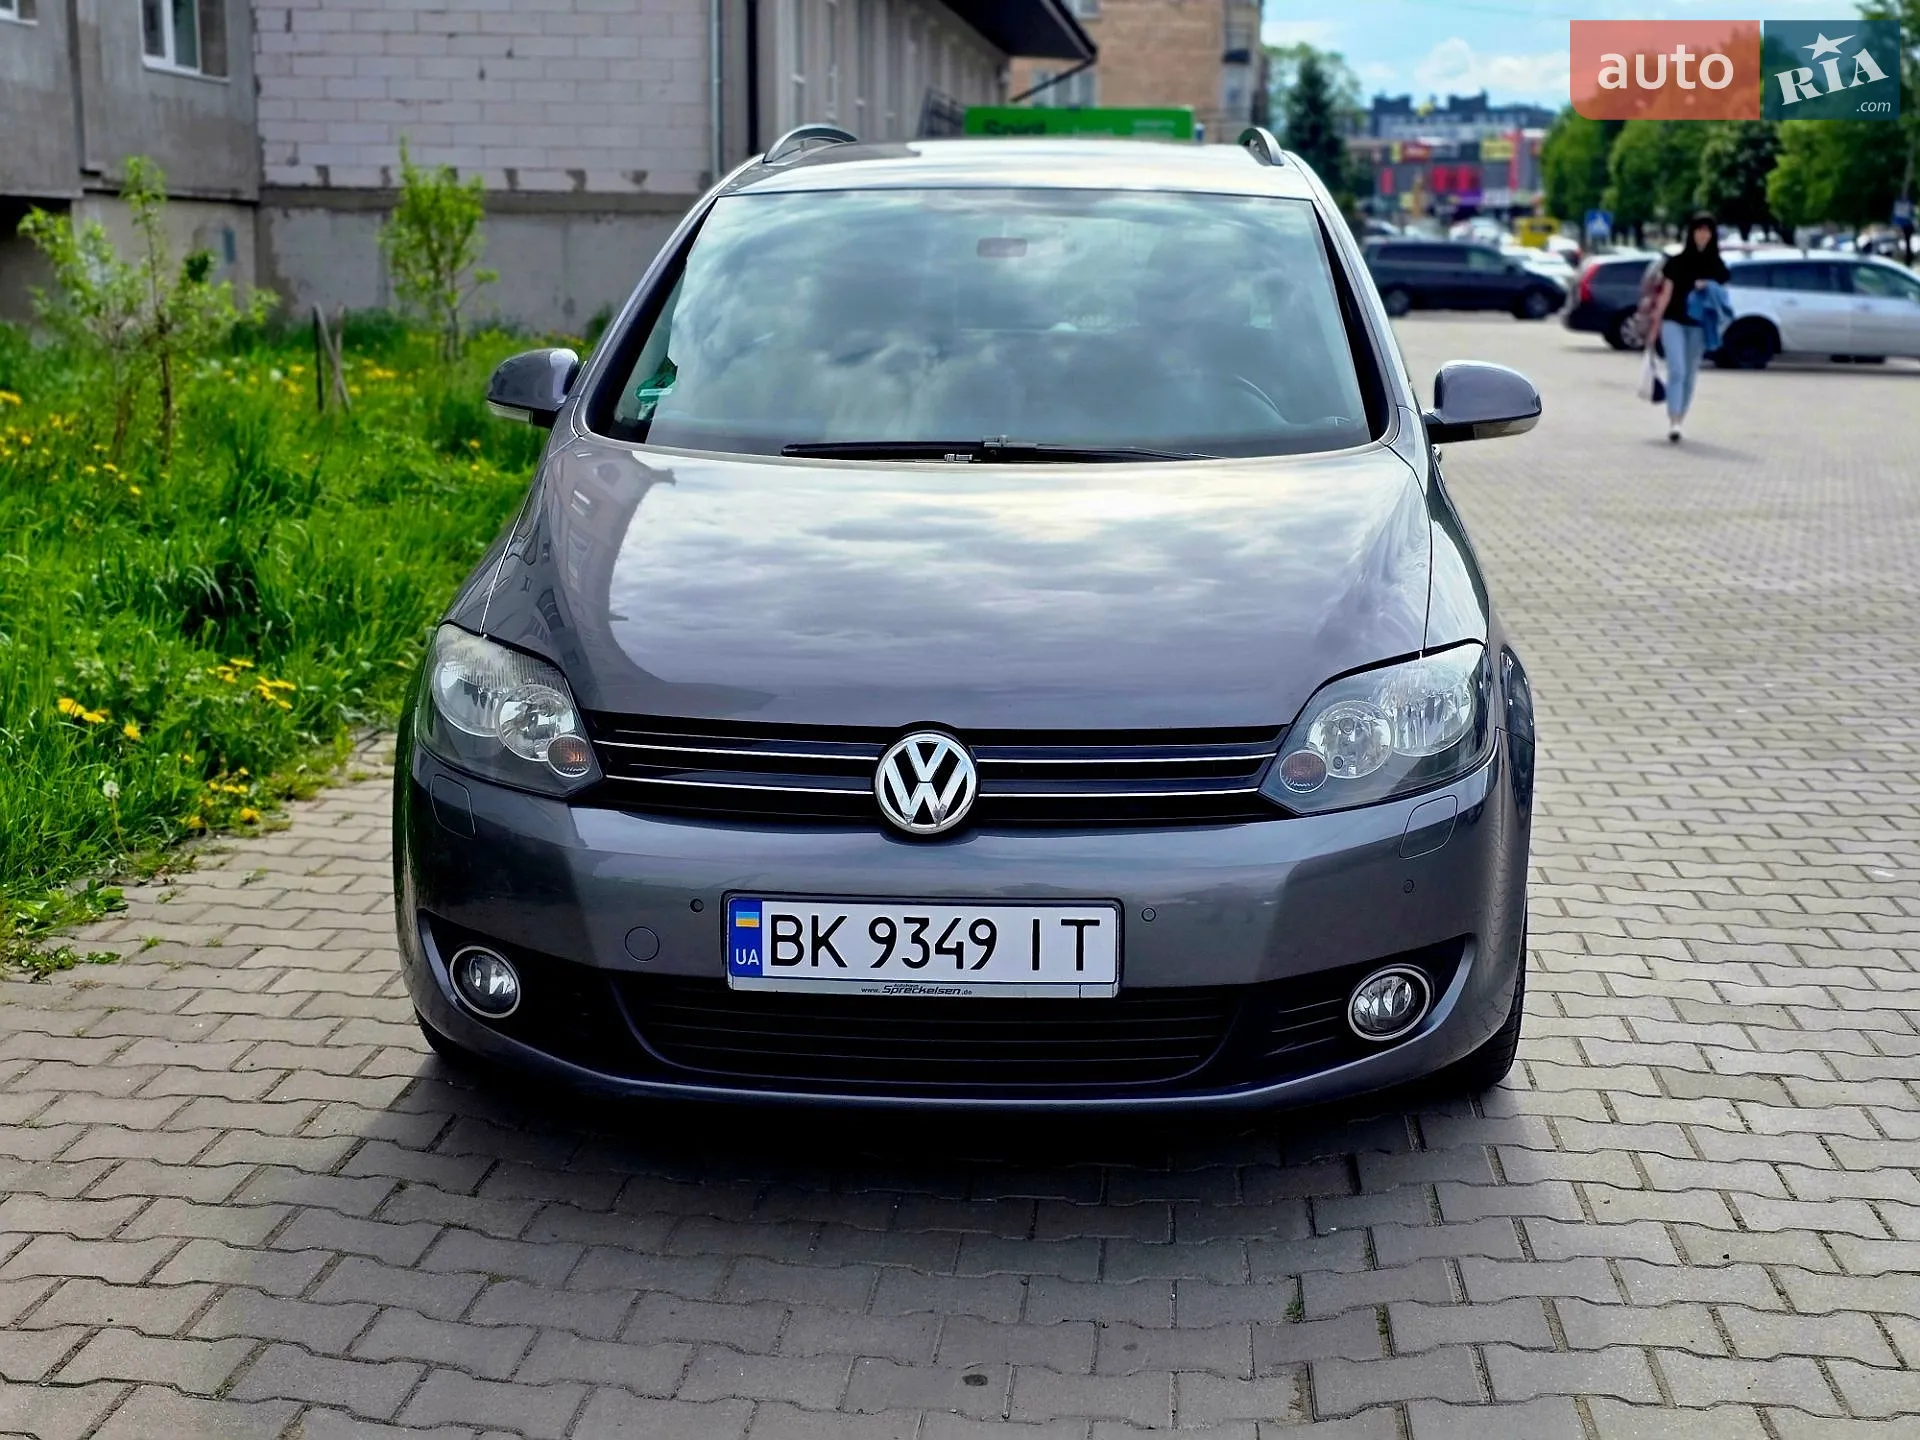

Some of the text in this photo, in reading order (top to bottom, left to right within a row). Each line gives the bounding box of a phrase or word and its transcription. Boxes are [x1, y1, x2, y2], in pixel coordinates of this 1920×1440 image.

[735, 948, 760, 966] UA
[770, 914, 848, 968] BK
[868, 916, 997, 970] 9349
